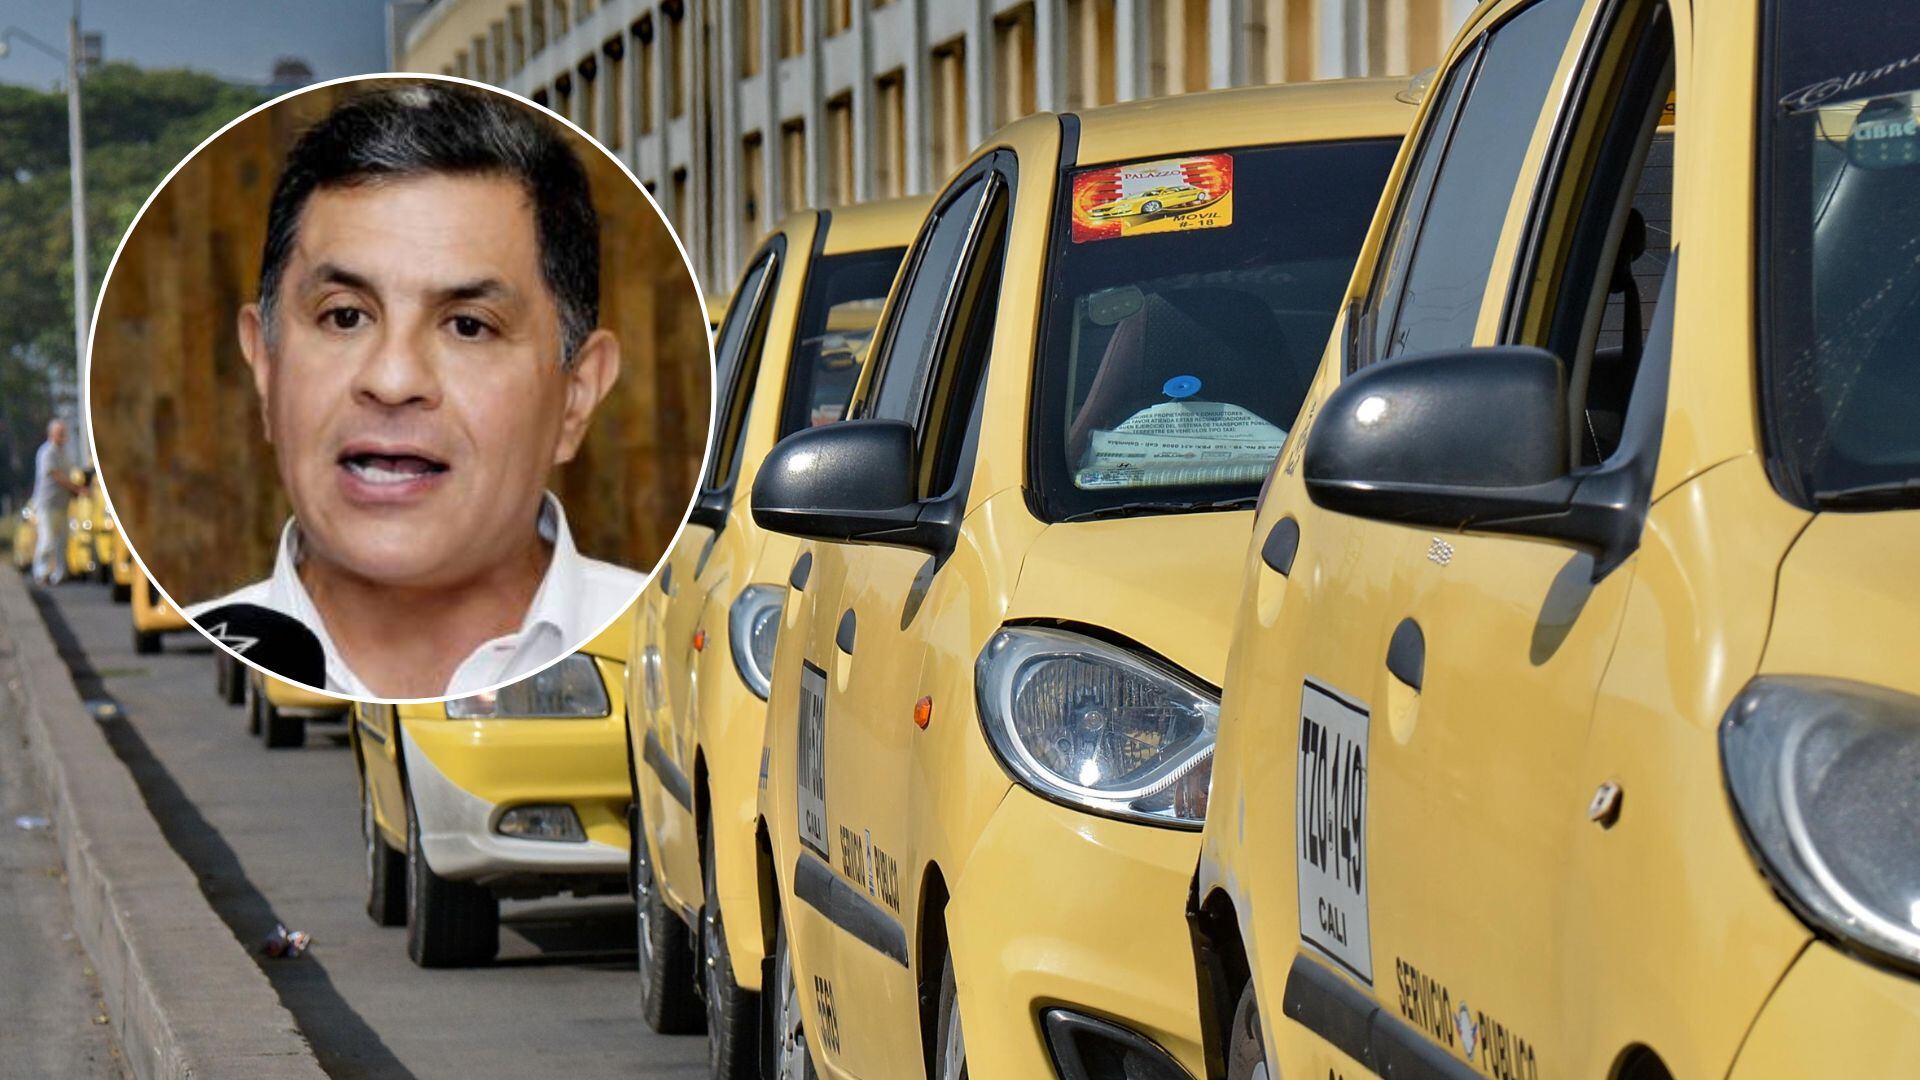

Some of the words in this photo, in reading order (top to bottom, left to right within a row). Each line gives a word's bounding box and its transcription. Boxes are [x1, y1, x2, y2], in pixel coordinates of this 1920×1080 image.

[1125, 169, 1181, 180] PALAZZO
[1173, 212, 1221, 222] MOVIL
[1198, 219, 1214, 227] 18
[806, 809, 821, 840] CALI
[839, 824, 866, 888] SERVICIO
[873, 845, 900, 915] PUBLICO
[1318, 896, 1347, 947] CALI
[1396, 956, 1454, 1048] SERVICIO
